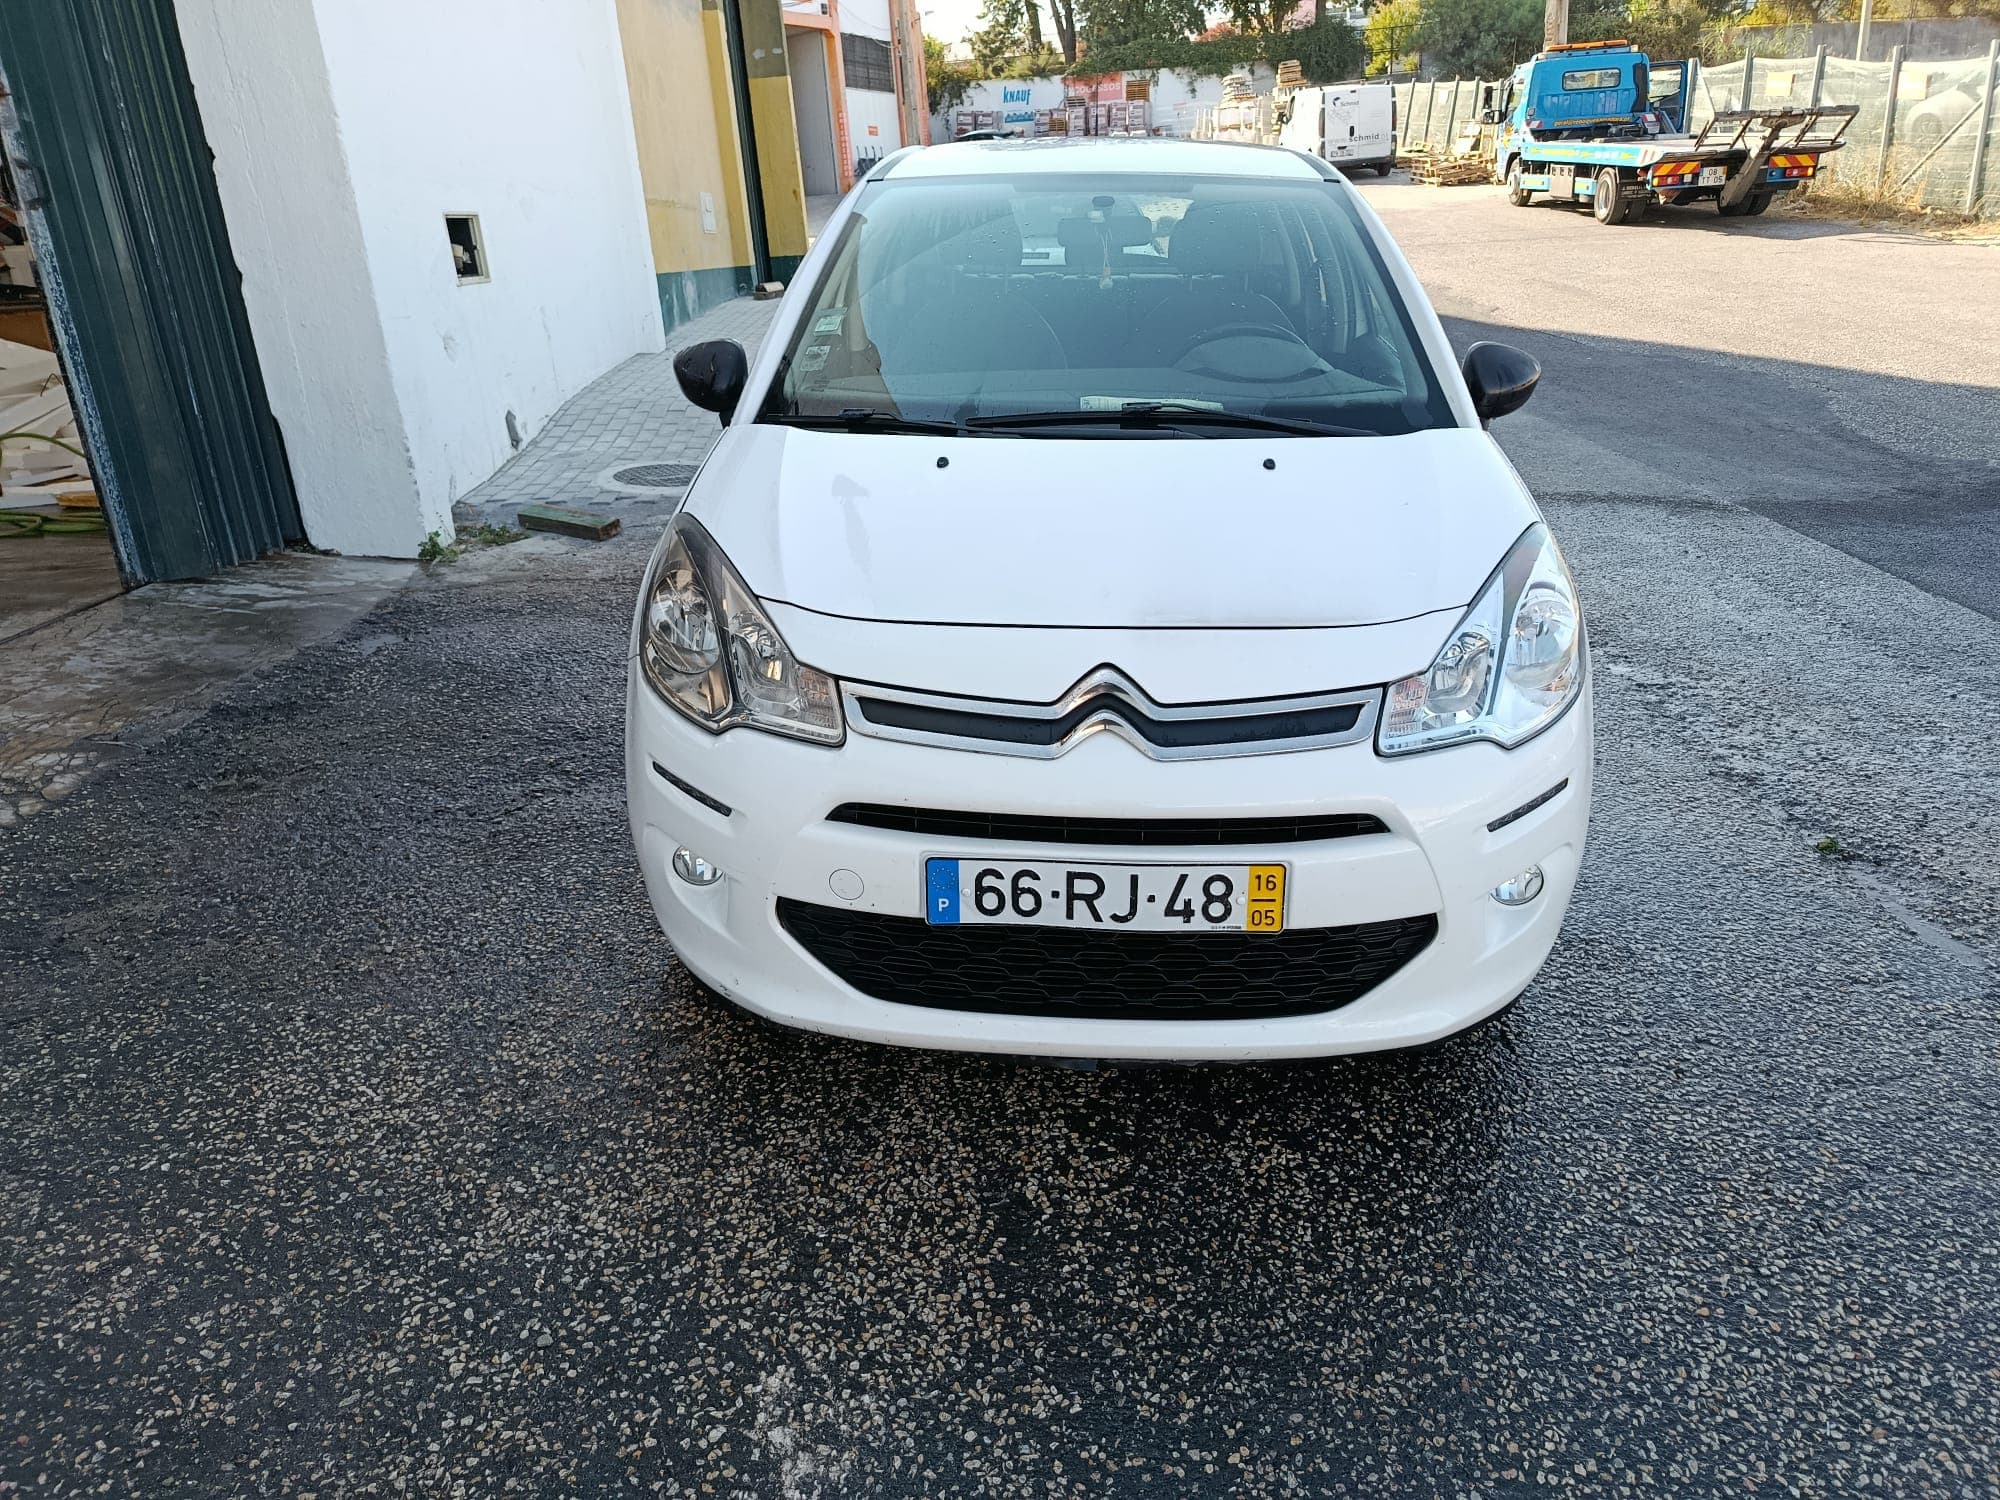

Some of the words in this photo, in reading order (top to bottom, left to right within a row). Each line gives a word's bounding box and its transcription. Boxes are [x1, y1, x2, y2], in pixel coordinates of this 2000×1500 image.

[1003, 85, 1031, 105] KNAUF
[1702, 176, 1710, 184] TT
[1254, 873, 1278, 891] 16
[938, 898, 948, 912] P
[1251, 909, 1276, 927] 05
